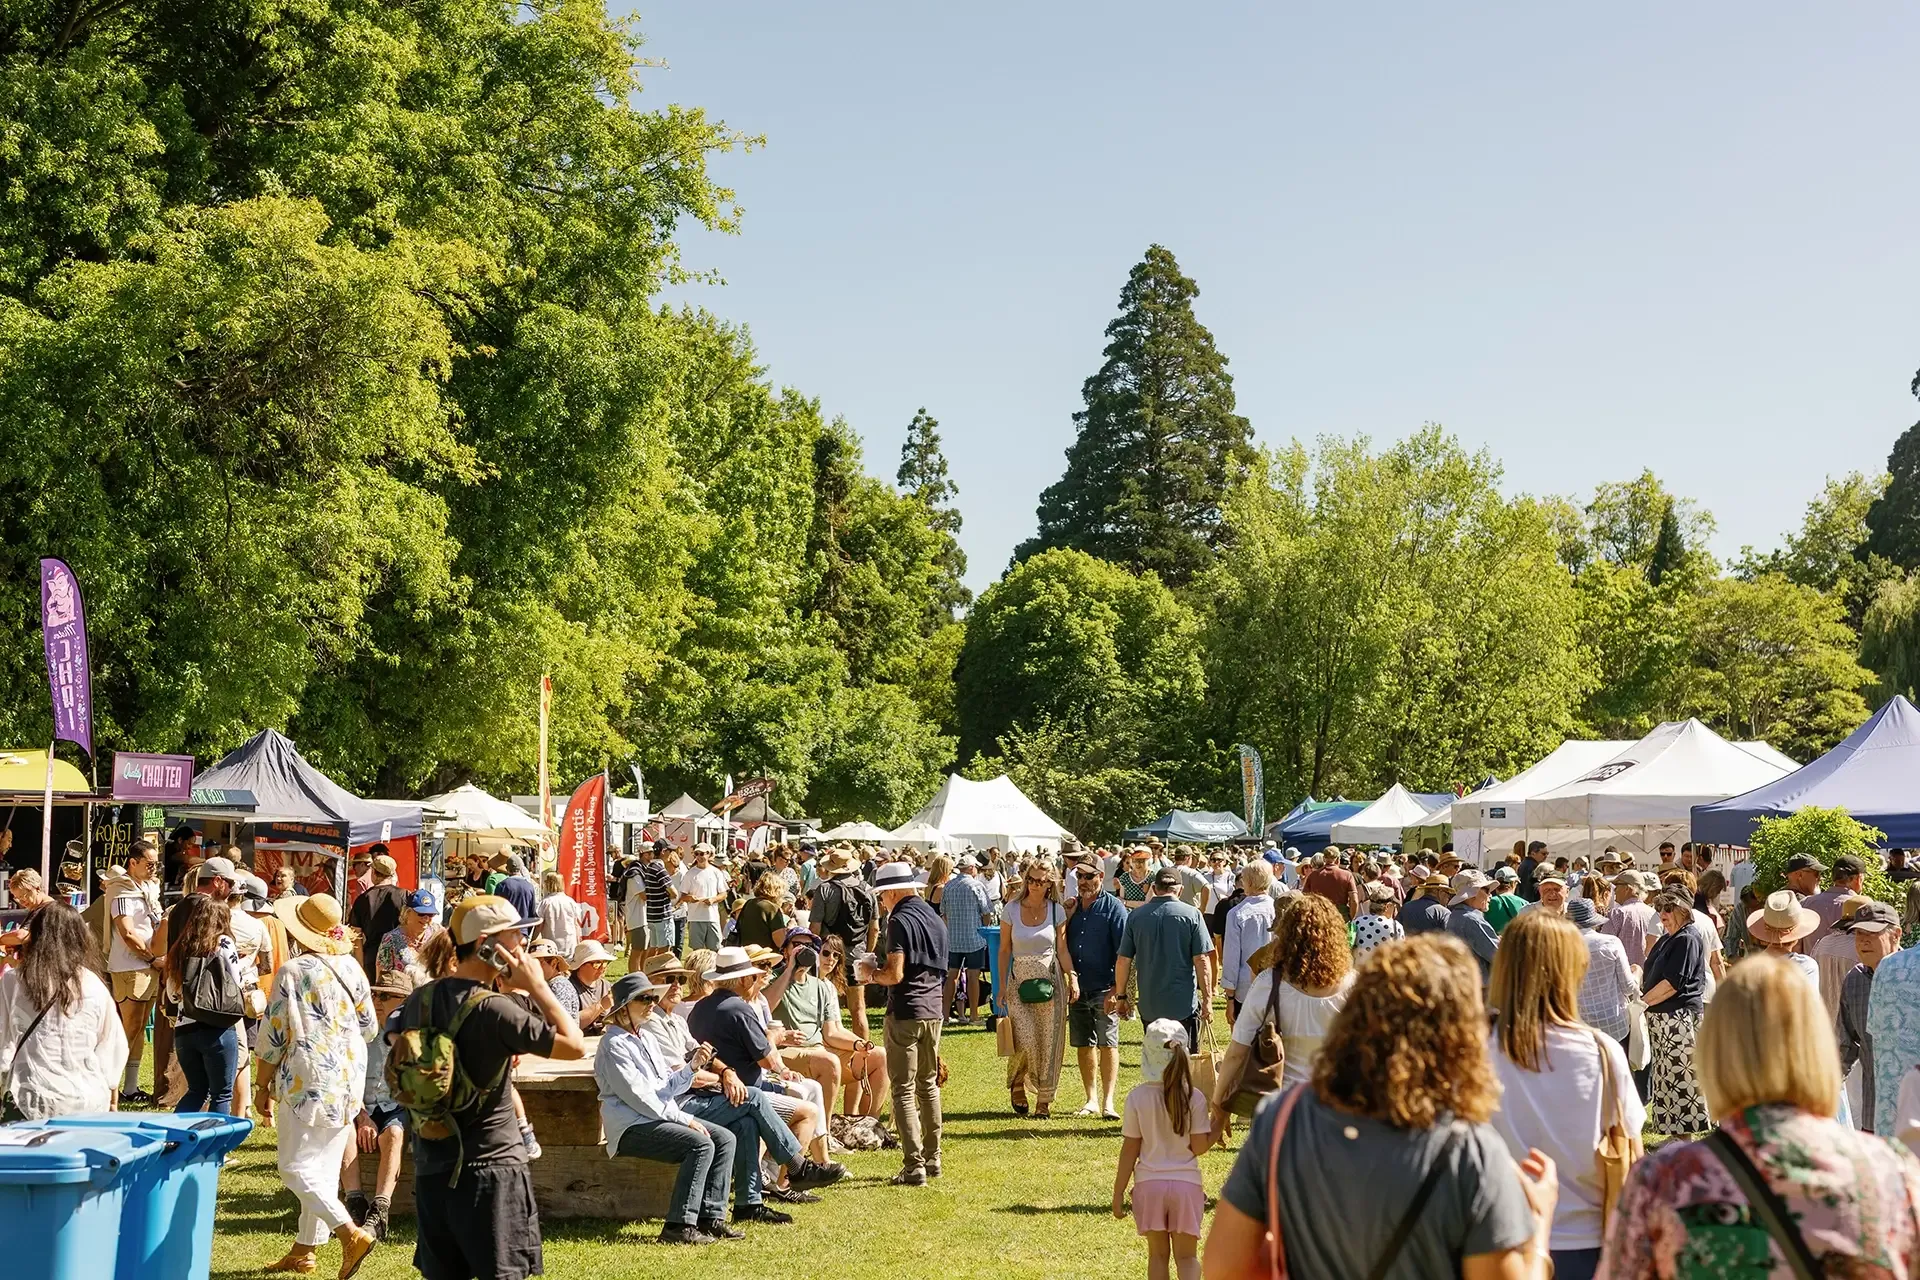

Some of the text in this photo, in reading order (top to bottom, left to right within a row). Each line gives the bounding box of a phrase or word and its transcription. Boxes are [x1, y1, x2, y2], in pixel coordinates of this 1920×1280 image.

[141, 764, 165, 788] CHAI
[165, 766, 182, 788] TEA
[95, 822, 134, 842] ROAST
[272, 822, 341, 838] RIDGE RYDER
[570, 807, 585, 886] Minghettis
[583, 825, 599, 867] Sourdough
[95, 856, 128, 868] BELY
[584, 867, 598, 897] Natural
